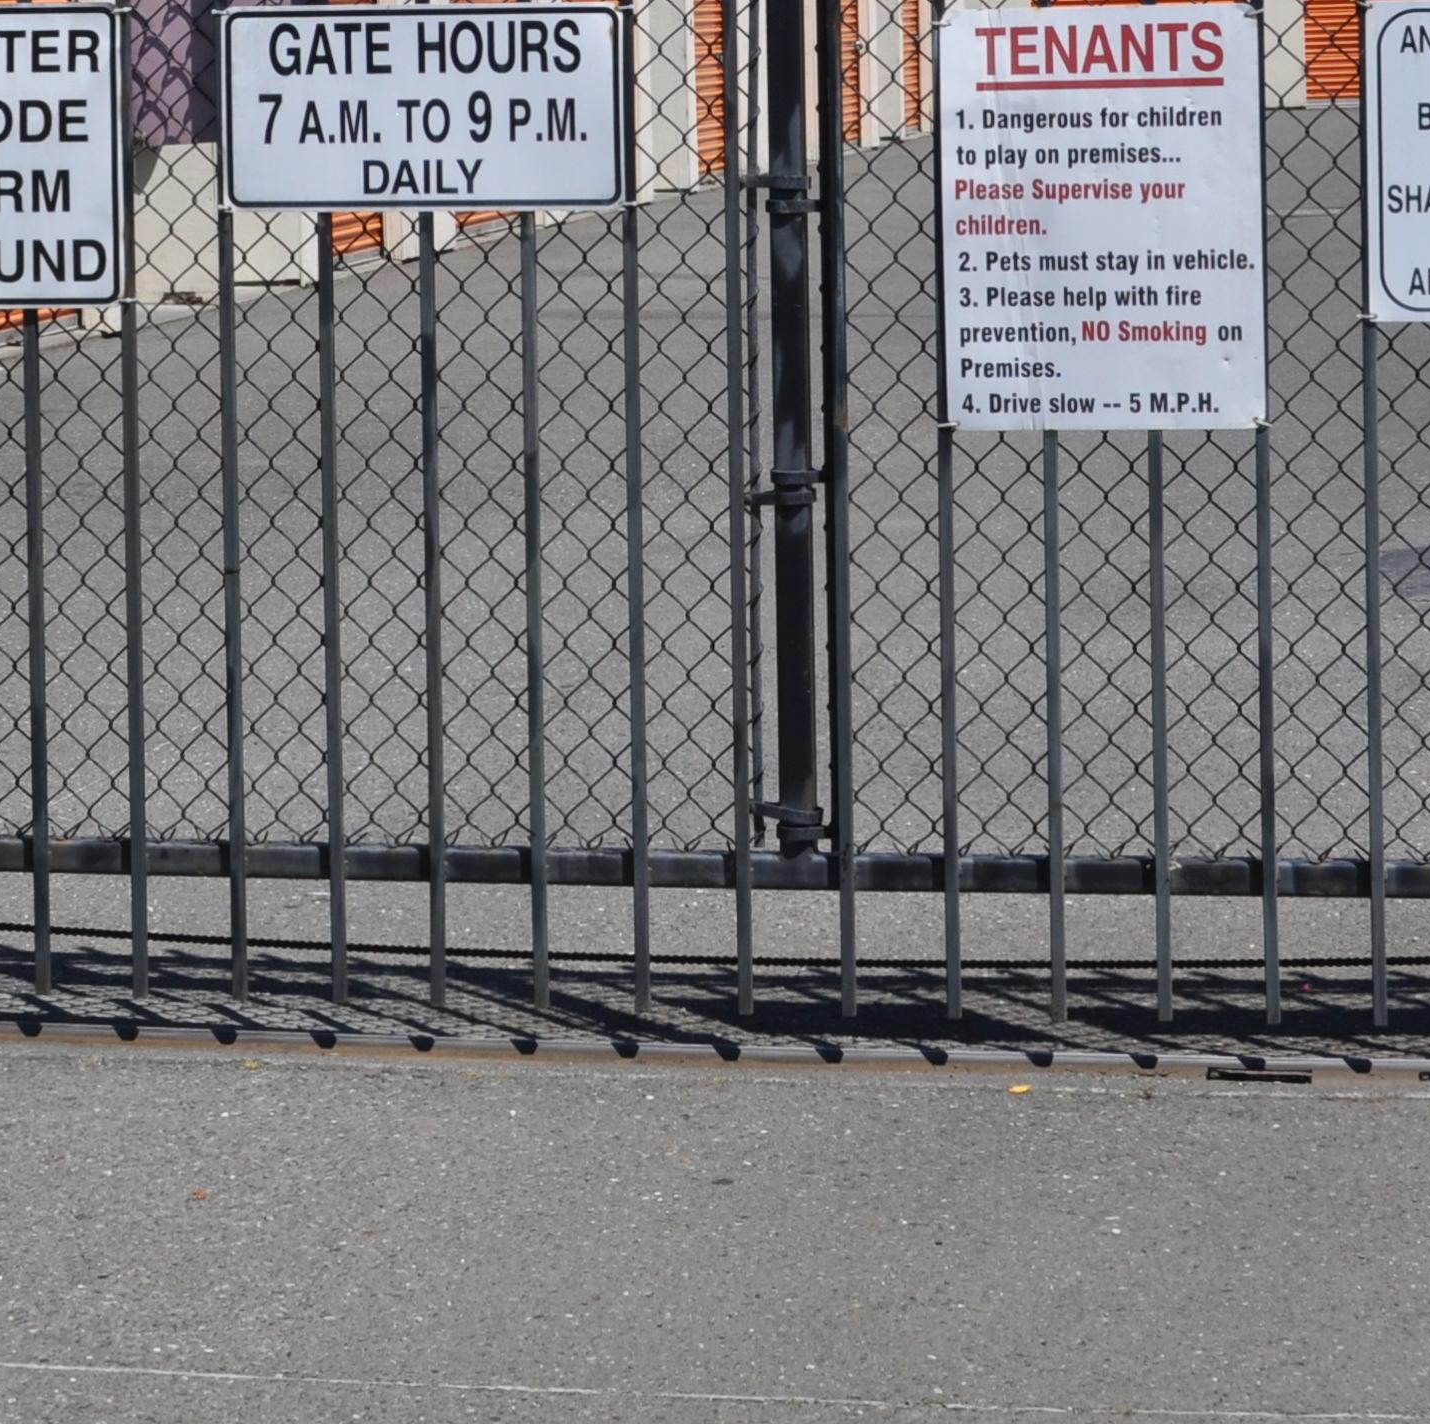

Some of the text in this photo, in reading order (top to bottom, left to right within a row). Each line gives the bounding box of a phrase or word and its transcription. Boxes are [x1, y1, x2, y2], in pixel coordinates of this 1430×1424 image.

[269, 19, 580, 76] GATE HOURS
[975, 21, 1223, 75] TENANTS
[259, 91, 586, 144] 7 A.M. TO 9 P.M.
[956, 107, 1221, 133] 1. Dangerous for children
[957, 143, 1180, 169] to play on premises...
[363, 159, 482, 194] DAILY
[955, 179, 1185, 204] Please Supervise your
[956, 215, 1046, 235] children.
[959, 249, 1254, 275] 2. Pets must stay in vehicle.
[960, 286, 1201, 311] 3. Please help with fire
[961, 321, 1242, 347] prevention, NO Smoking on
[961, 358, 1061, 378] Premises.
[962, 394, 980, 413] 4.
[990, 393, 1040, 413] Drive
[1050, 393, 1094, 413] slow
[1130, 393, 1141, 413] 5
[1150, 393, 1218, 413] M.P.H.
